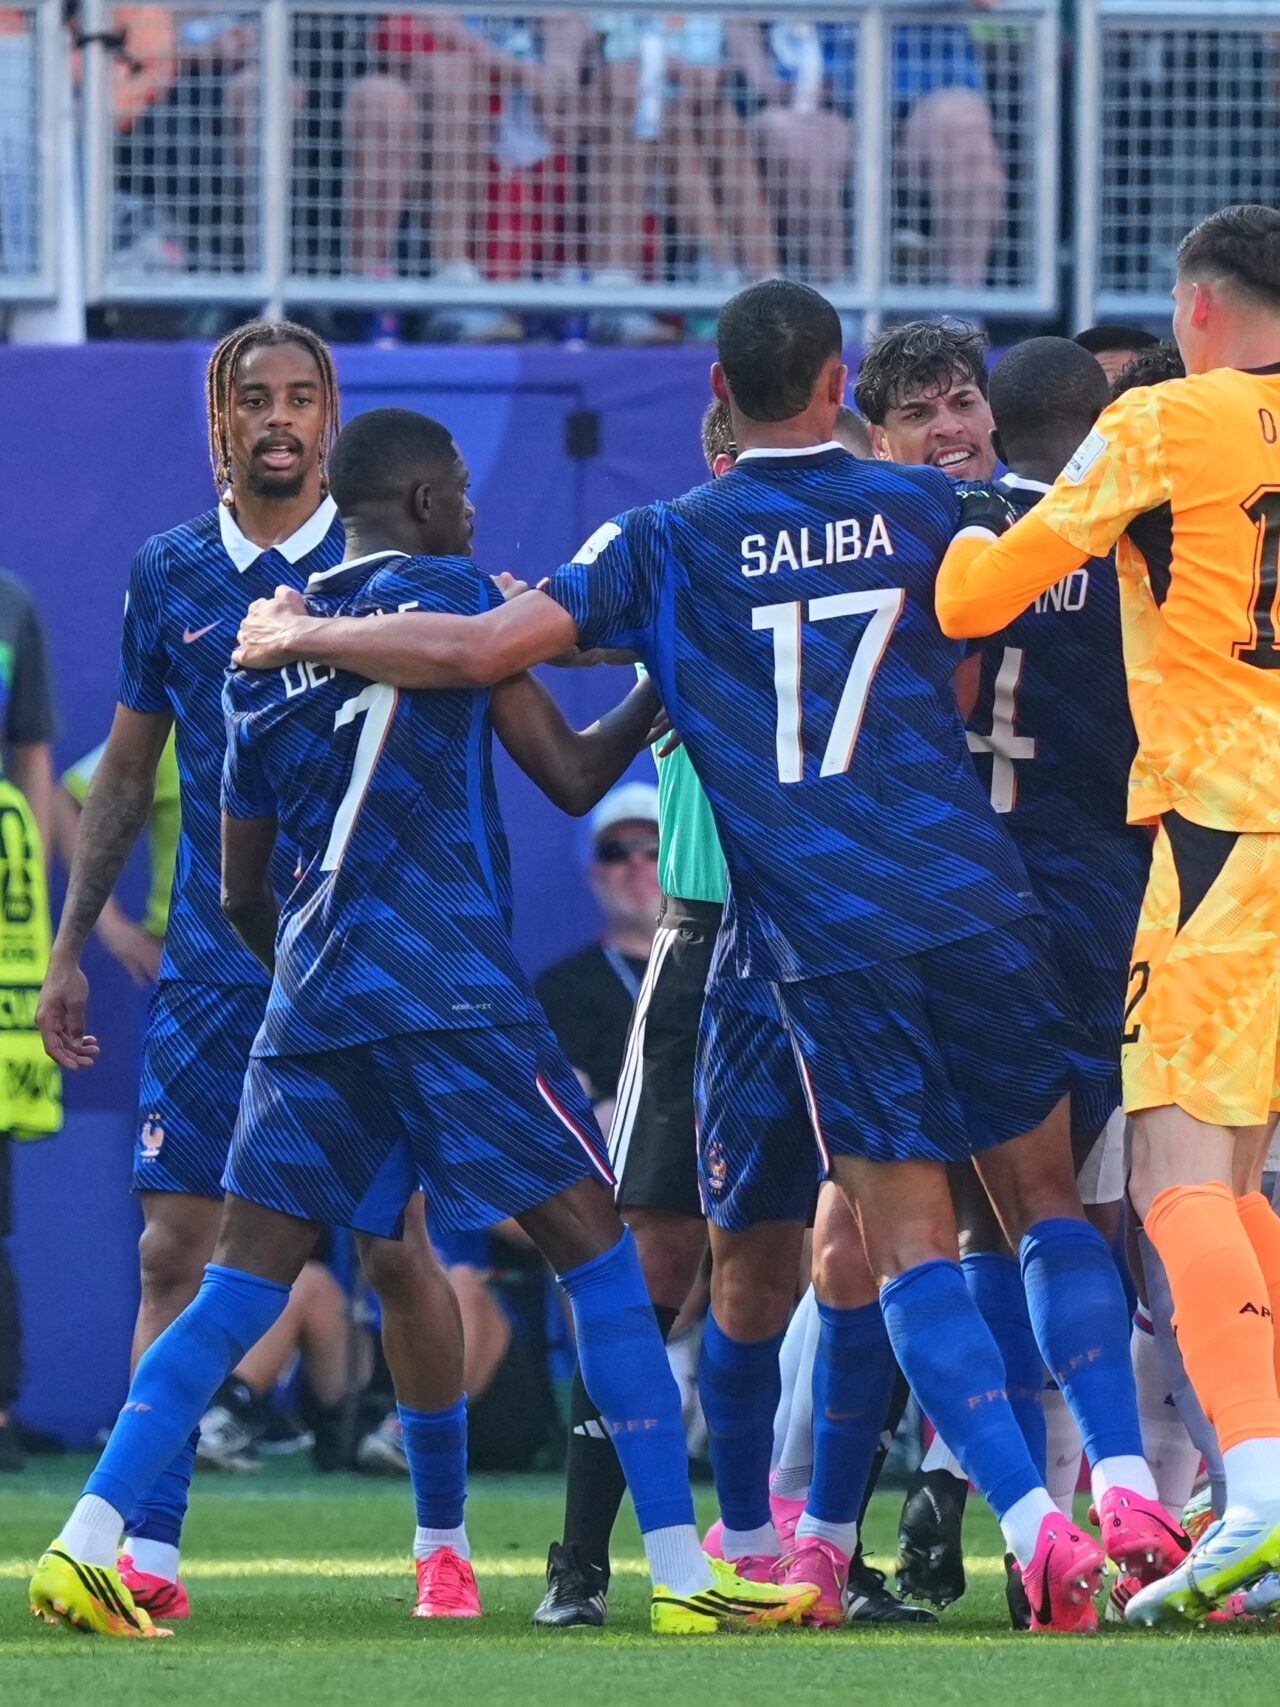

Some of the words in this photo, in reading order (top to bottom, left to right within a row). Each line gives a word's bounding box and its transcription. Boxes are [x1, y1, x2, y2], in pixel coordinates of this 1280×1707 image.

[740, 514, 894, 578] SALIBA
[751, 587, 905, 784] 17
[320, 682, 398, 871] 7
[1122, 960, 1151, 1045] 2
